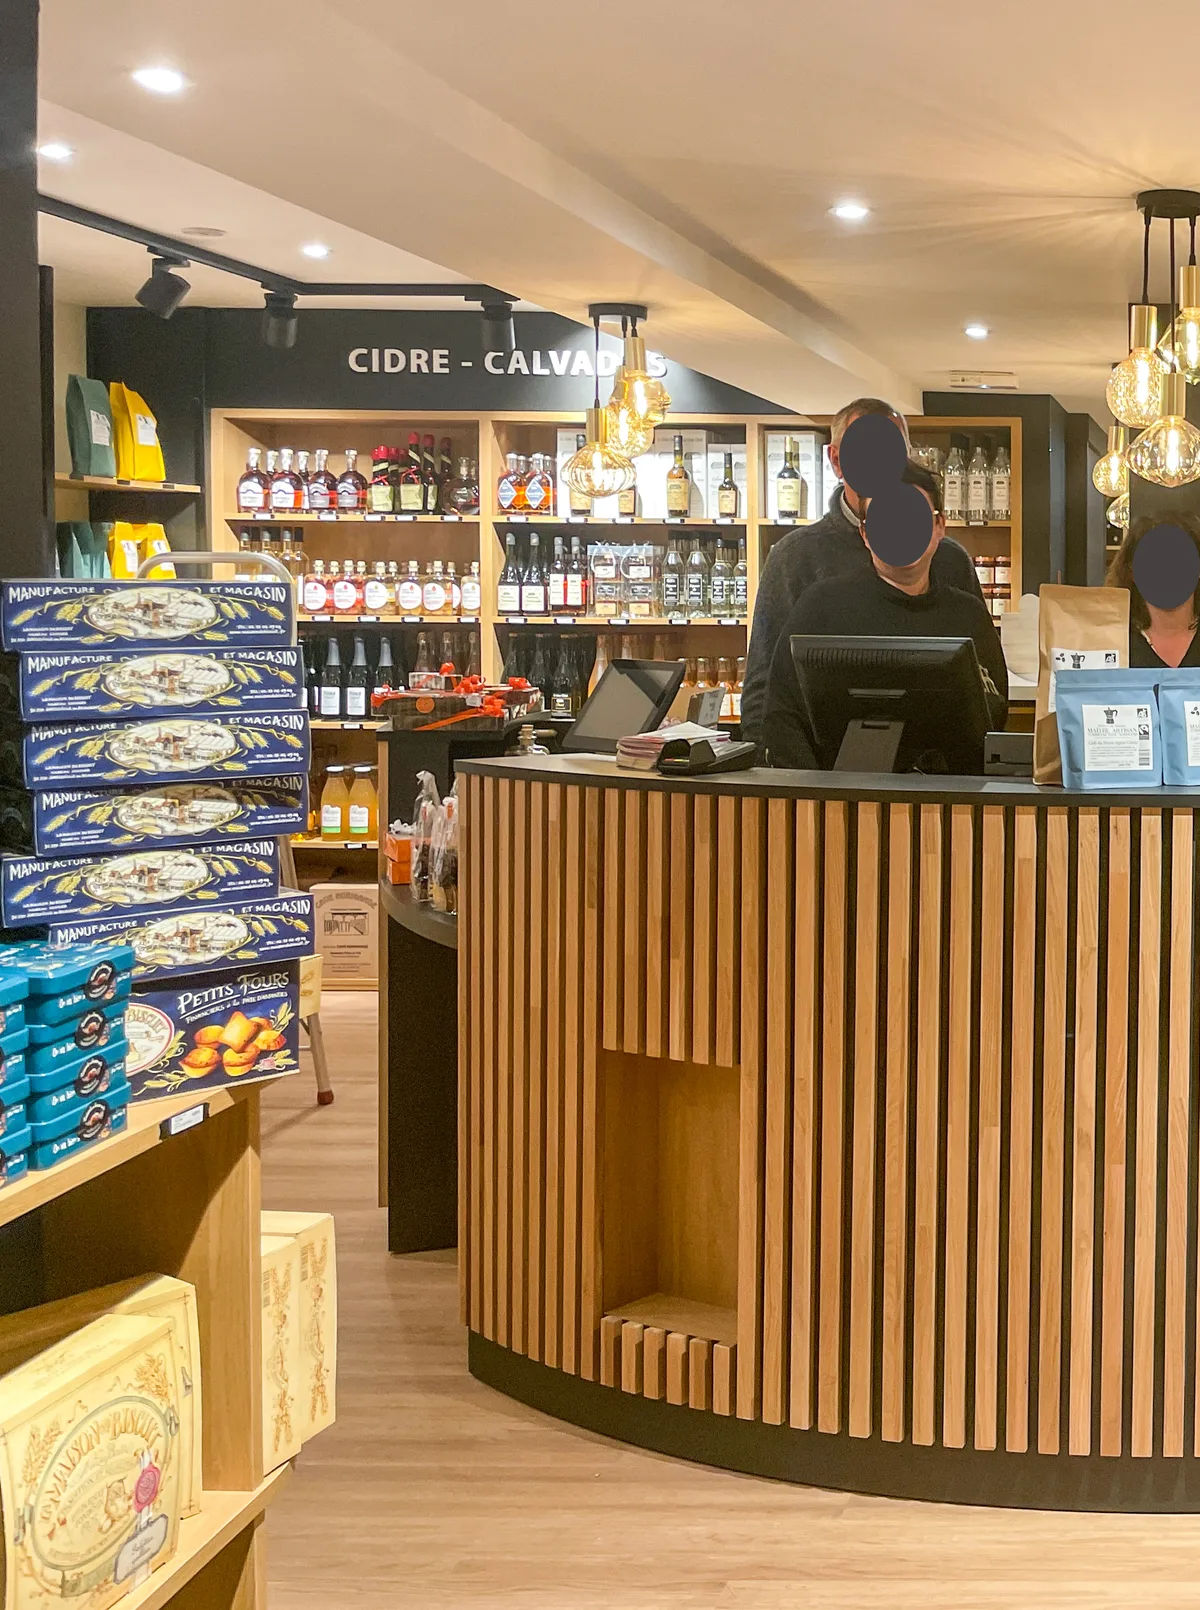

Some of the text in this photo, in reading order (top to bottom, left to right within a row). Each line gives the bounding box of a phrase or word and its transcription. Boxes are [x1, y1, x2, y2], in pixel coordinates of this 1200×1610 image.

[348, 347, 450, 375] CIDRE
[484, 349, 668, 377] CALVADS
[8, 586, 96, 604] MANUFACTURE
[209, 586, 287, 603] ET MAGASIN
[27, 653, 114, 674] MANUFACTURE
[223, 650, 298, 667] ET MAGASIN
[243, 714, 304, 731] MAGASIN
[246, 776, 304, 791] MAGASIN
[201, 840, 275, 856] ET MAGASIN
[9, 857, 94, 881] MANUFACTURE
[241, 905, 253, 914] ET
[255, 899, 311, 916] MAGASIN
[57, 920, 138, 944] MANUFACTURE
[177, 983, 235, 1015] PETITS
[127, 1008, 169, 1034] BISCUIT
[110, 1407, 164, 1450] BISCUIT
